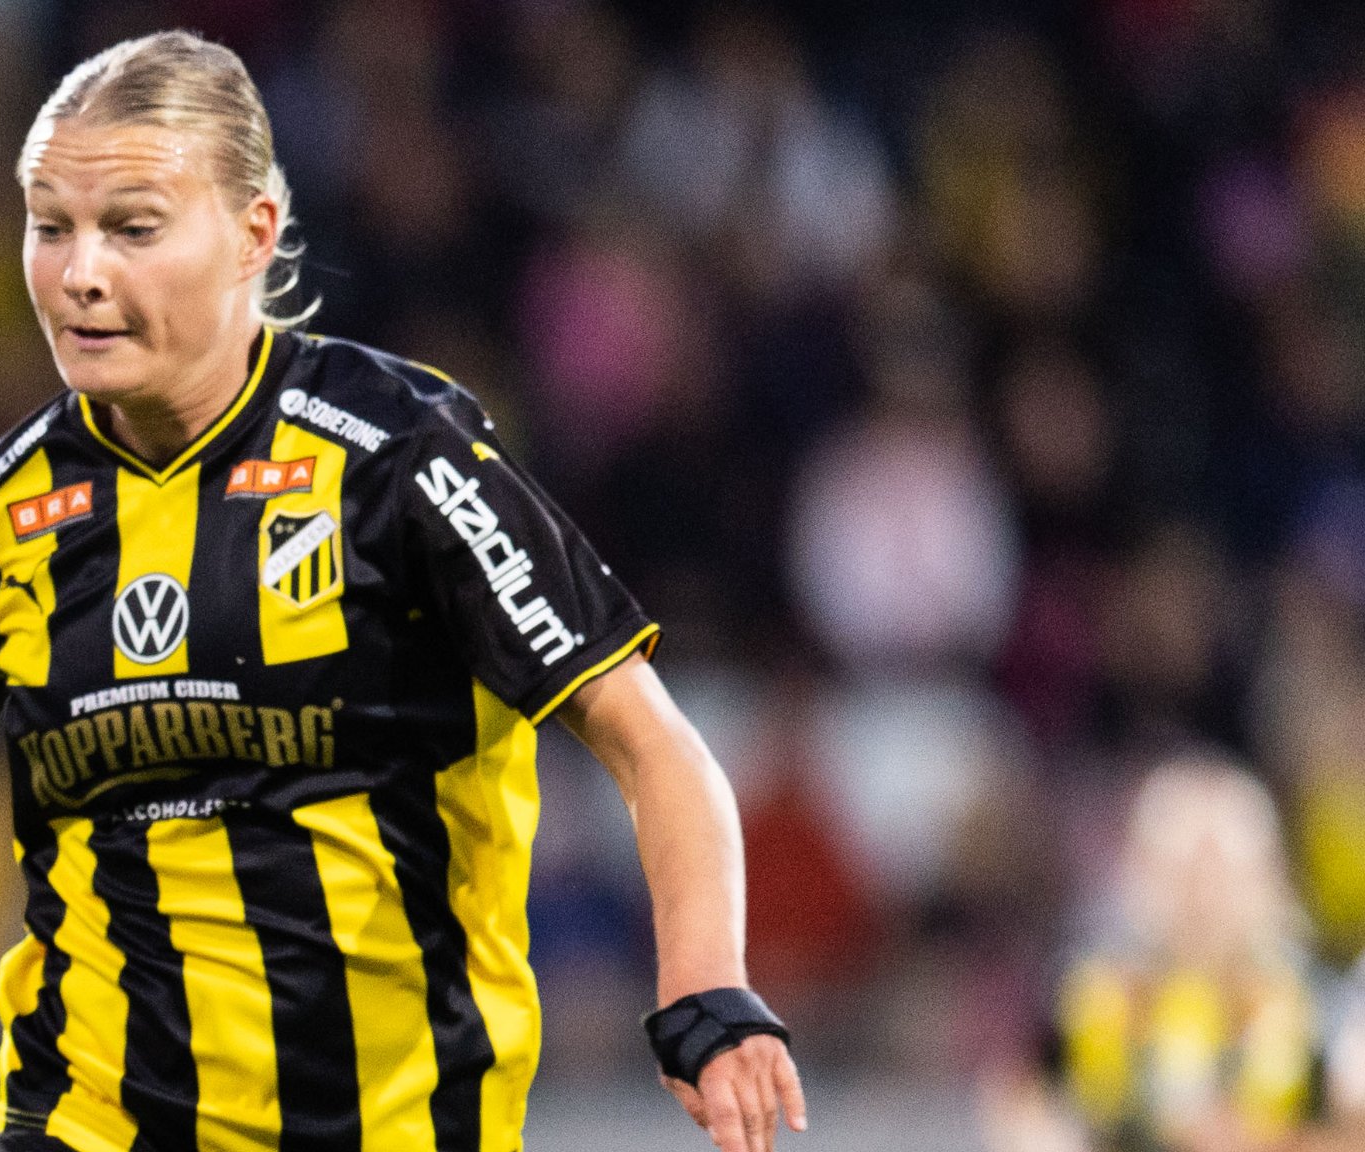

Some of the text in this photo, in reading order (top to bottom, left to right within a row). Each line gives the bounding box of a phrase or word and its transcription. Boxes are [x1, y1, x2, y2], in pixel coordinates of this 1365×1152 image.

[232, 465, 309, 486] BRA
[18, 490, 87, 527] BRA
[414, 456, 575, 667] stadium
[115, 577, 186, 658] VW
[70, 679, 240, 717] PREMIUM CIDER
